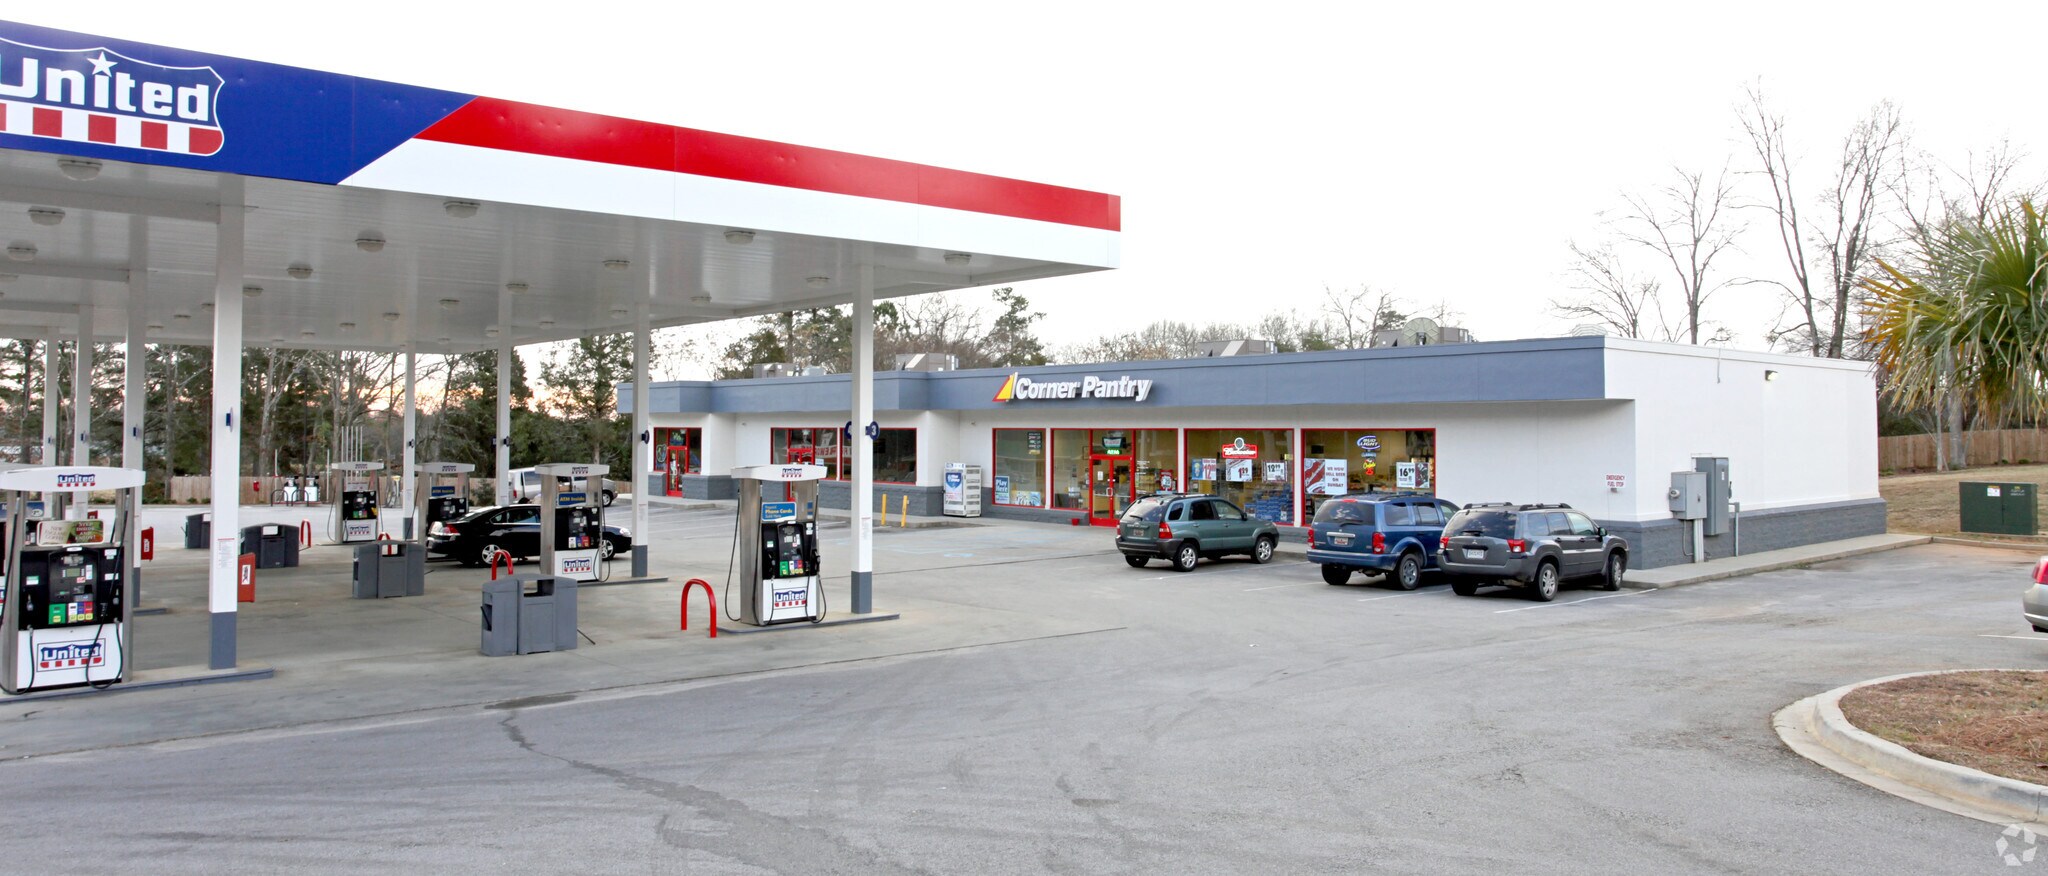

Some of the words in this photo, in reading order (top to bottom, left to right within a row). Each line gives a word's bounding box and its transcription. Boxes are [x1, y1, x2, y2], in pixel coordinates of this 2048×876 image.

[0, 54, 210, 122] United
[1015, 377, 1080, 400] Corner
[1081, 375, 1153, 402] Pantry
[871, 425, 877, 436] 3
[60, 474, 94, 483] United
[776, 591, 805, 602] United
[43, 644, 100, 660] United
